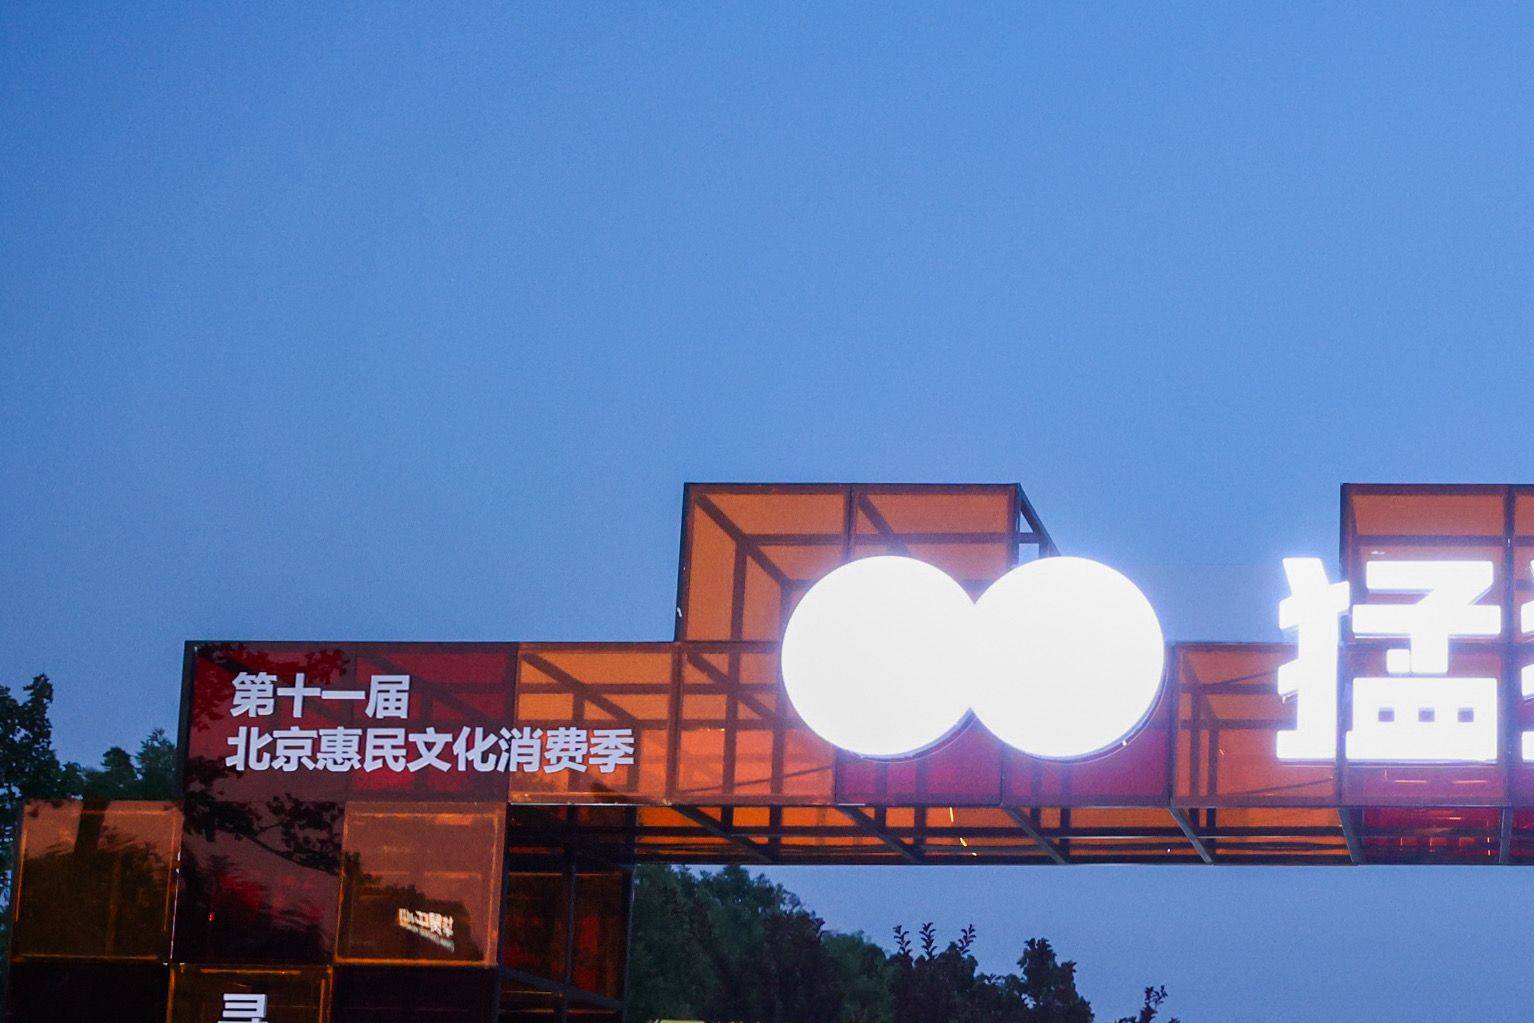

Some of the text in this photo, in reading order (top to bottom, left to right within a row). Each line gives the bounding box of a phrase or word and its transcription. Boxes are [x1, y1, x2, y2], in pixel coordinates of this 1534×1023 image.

[230, 671, 410, 719] 第十一届
[225, 725, 635, 774] 北京惠民文化消费季
